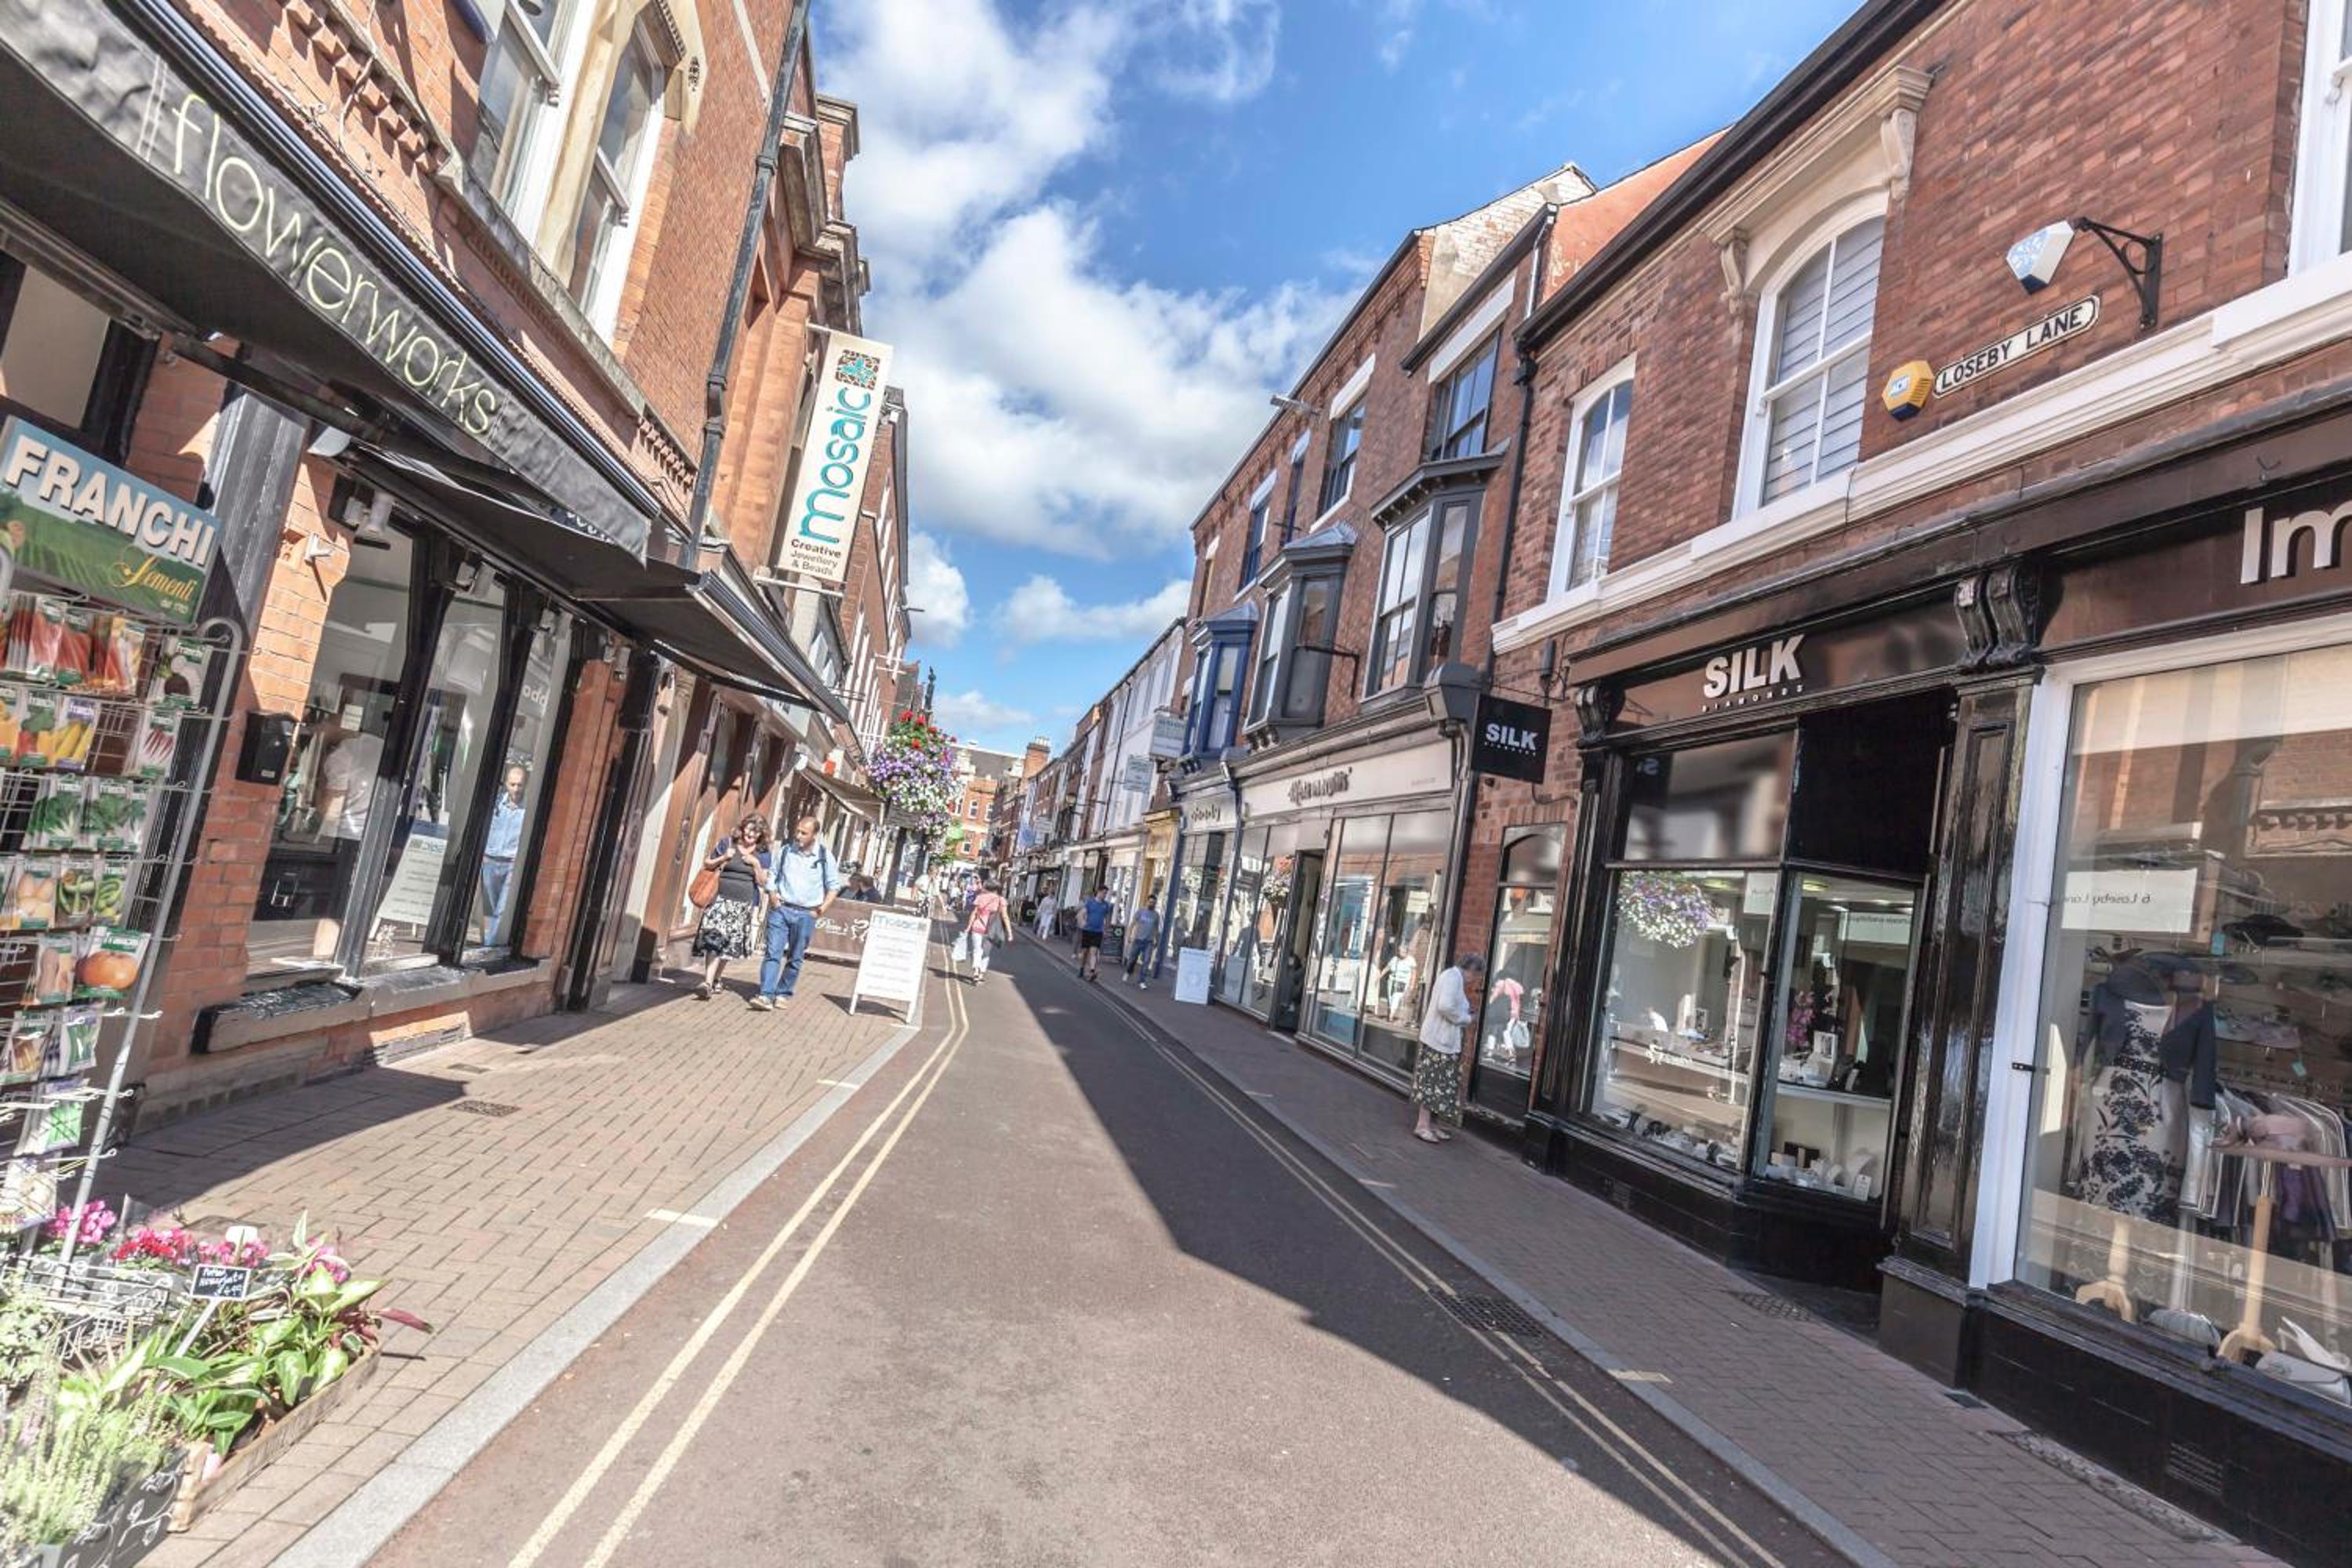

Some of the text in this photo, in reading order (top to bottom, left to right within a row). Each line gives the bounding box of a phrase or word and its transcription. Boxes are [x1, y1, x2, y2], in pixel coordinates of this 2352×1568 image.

[172, 93, 499, 436] flowerworks
[1941, 306, 2082, 390] LOSEBY LANE
[798, 387, 872, 544] mosaic
[5, 437, 216, 566] FRANCHI
[790, 550, 838, 568] Jewellery
[791, 539, 841, 558] Creative
[802, 561, 833, 576] Beads
[1703, 634, 1805, 699] SILK
[1486, 723, 1538, 750] SILK
